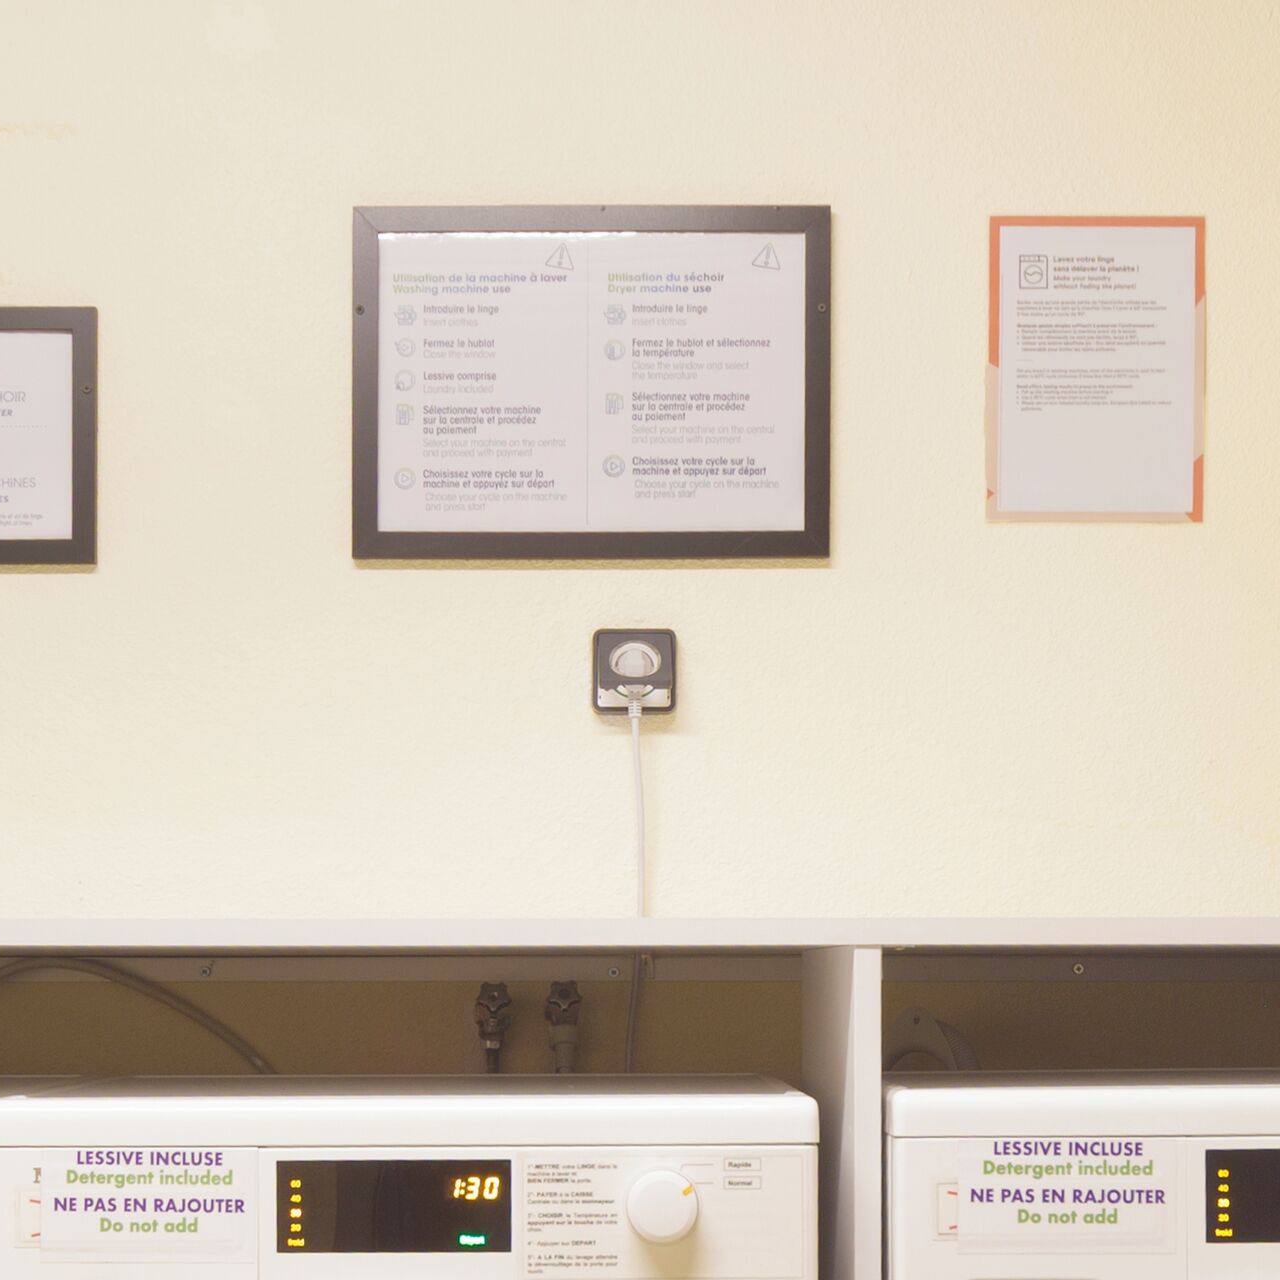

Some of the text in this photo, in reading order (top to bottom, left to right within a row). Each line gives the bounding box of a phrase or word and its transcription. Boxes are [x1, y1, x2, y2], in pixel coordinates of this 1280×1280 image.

[993, 1141, 1144, 1157] LESSIVE INCLUSE
[76, 1150, 224, 1167] LESSIVE INCLUSE
[65, 1168, 234, 1188] Detergent included
[982, 1159, 1154, 1179] Detergent included
[452, 1175, 501, 1201] 1:30
[969, 1188, 1166, 1205] NE PAS EN RAJOUTER
[53, 1196, 246, 1214] NE PAS EN RAJOUTER
[99, 1216, 199, 1234] Do not add
[1016, 1207, 1119, 1225] Do not add
